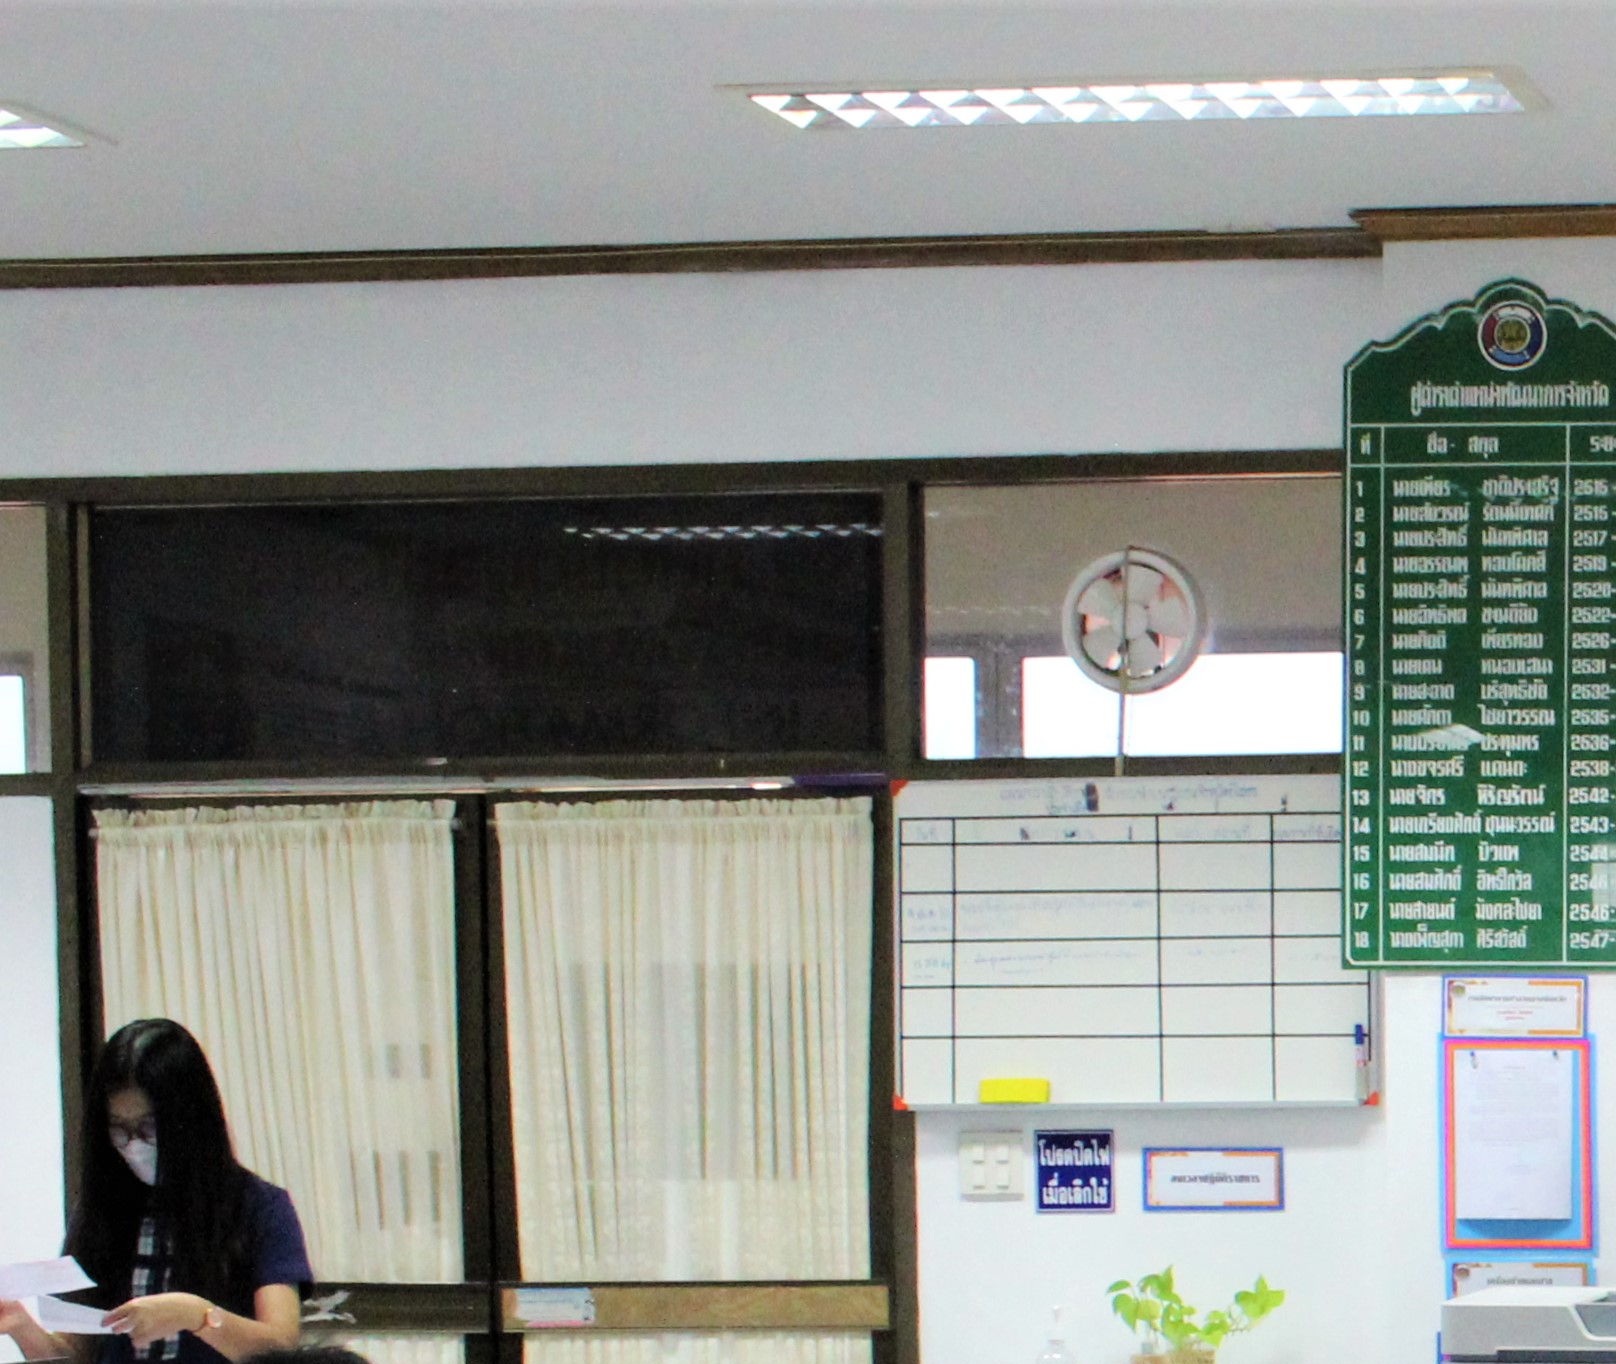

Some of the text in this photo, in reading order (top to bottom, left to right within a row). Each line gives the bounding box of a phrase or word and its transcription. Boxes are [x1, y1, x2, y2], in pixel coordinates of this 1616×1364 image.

[1355, 481, 1364, 497] 1
[1355, 507, 1365, 522] 2
[1355, 531, 1365, 547] 3
[1355, 558, 1366, 574] 4
[1355, 583, 1365, 599] 5
[1354, 609, 1365, 624] 6
[1355, 634, 1365, 650] 7
[1355, 660, 1365, 675] 8
[1353, 685, 1365, 700] 9
[1353, 710, 1370, 727] 10
[1353, 735, 1365, 751] 11
[1353, 761, 1369, 777] 12
[1353, 790, 1370, 805] 13
[1352, 817, 1370, 834] 14
[1353, 846, 1370, 861] 15
[1353, 874, 1370, 890] 16
[1354, 904, 1369, 920] 17
[1355, 932, 1369, 948] 18
[1038, 1138, 1112, 1167] โปรดปิดไฟ
[1042, 1172, 1108, 1206] เมื่อเลิกใช้
